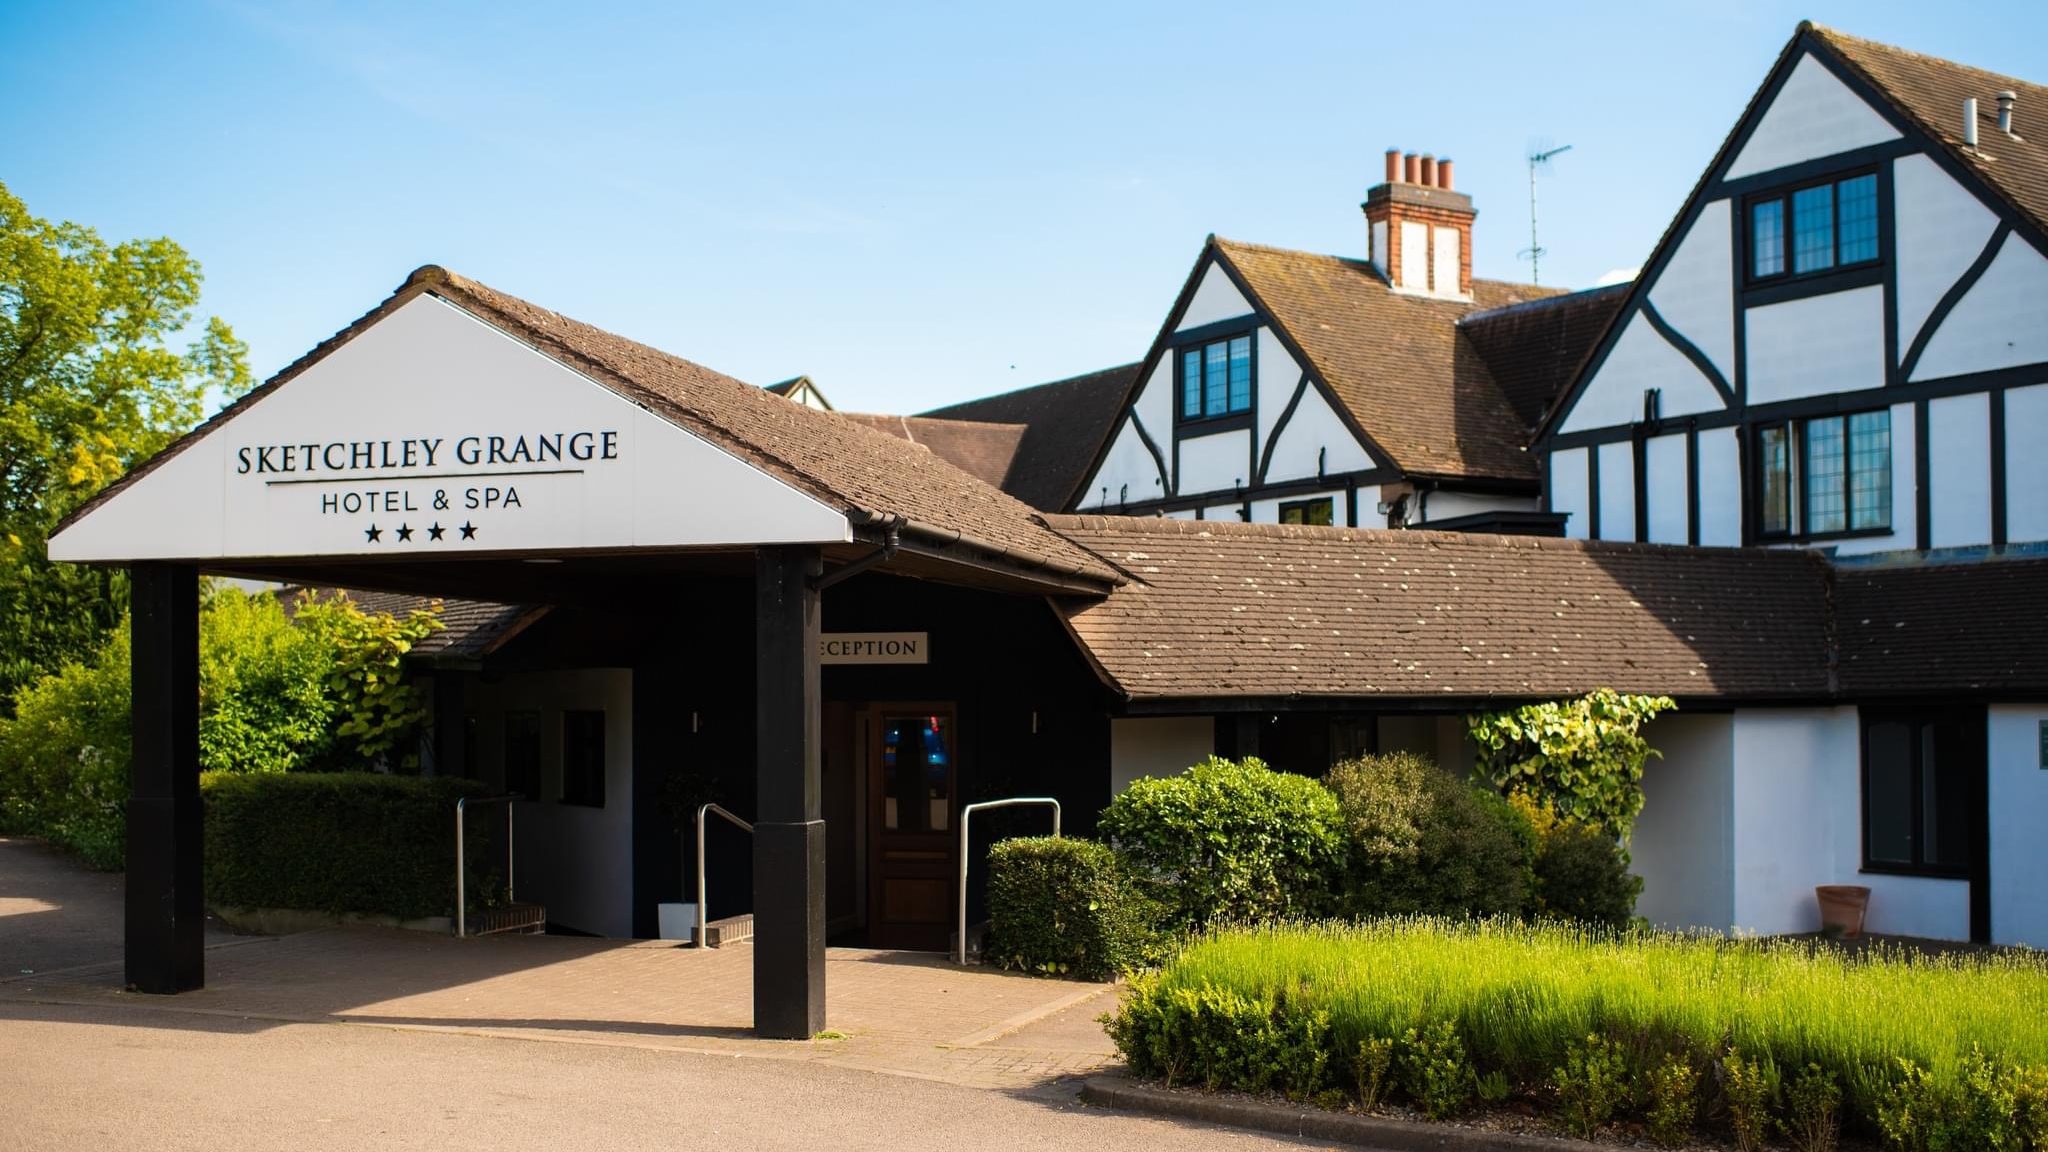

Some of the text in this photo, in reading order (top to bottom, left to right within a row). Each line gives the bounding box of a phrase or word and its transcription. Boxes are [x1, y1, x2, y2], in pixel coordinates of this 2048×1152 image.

[237, 431, 619, 474] SKETCHLEY GRANGE
[322, 486, 522, 515] HOTEL & SPA
